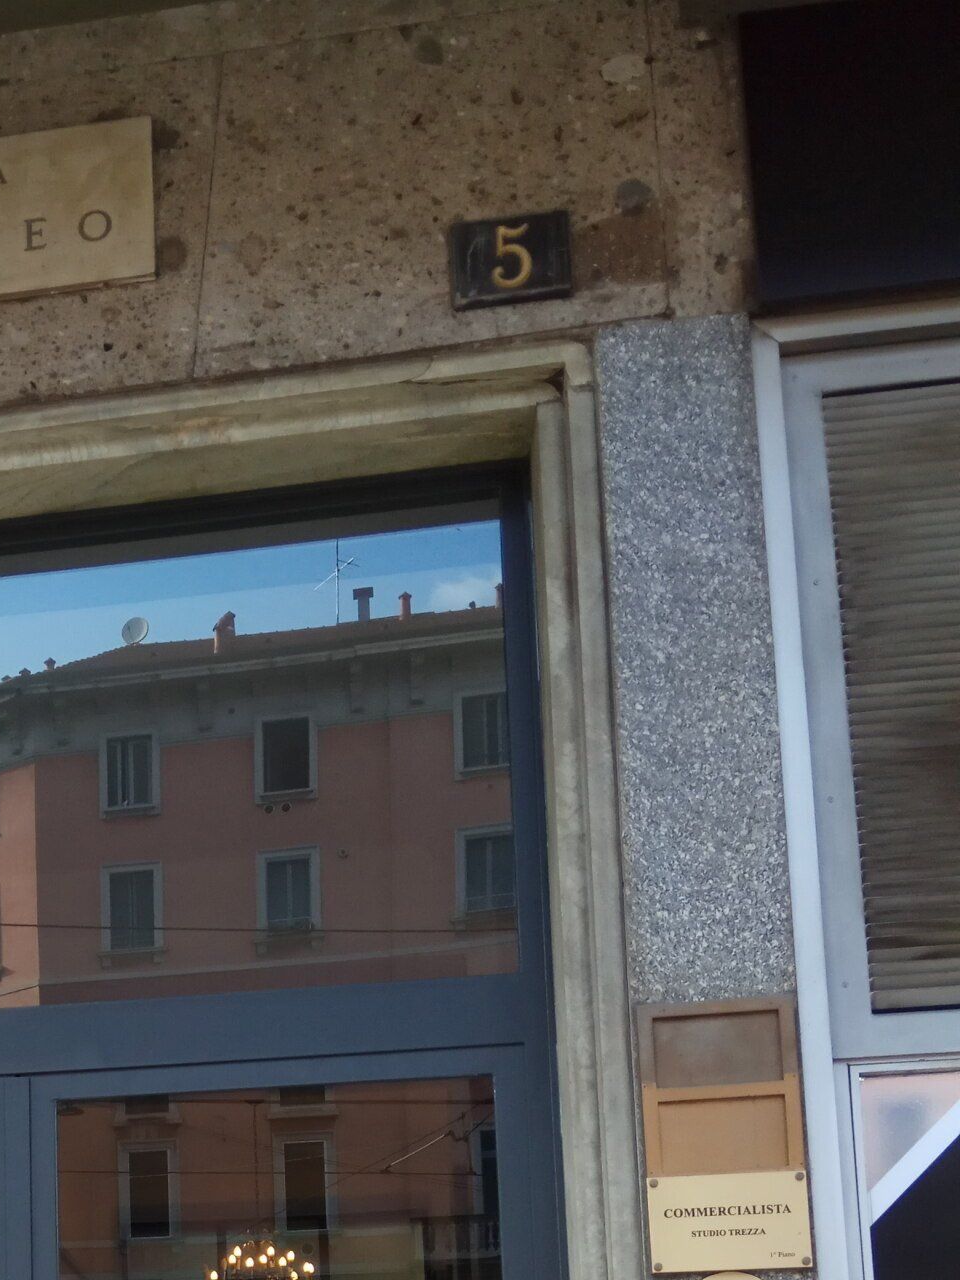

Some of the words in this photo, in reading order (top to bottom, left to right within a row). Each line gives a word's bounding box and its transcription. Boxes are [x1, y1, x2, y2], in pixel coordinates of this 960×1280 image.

[491, 222, 532, 288] 5
[663, 1203, 792, 1219] COMMERCIALISTA
[691, 1229, 727, 1238] STUDIO
[729, 1227, 766, 1236] TREZZA
